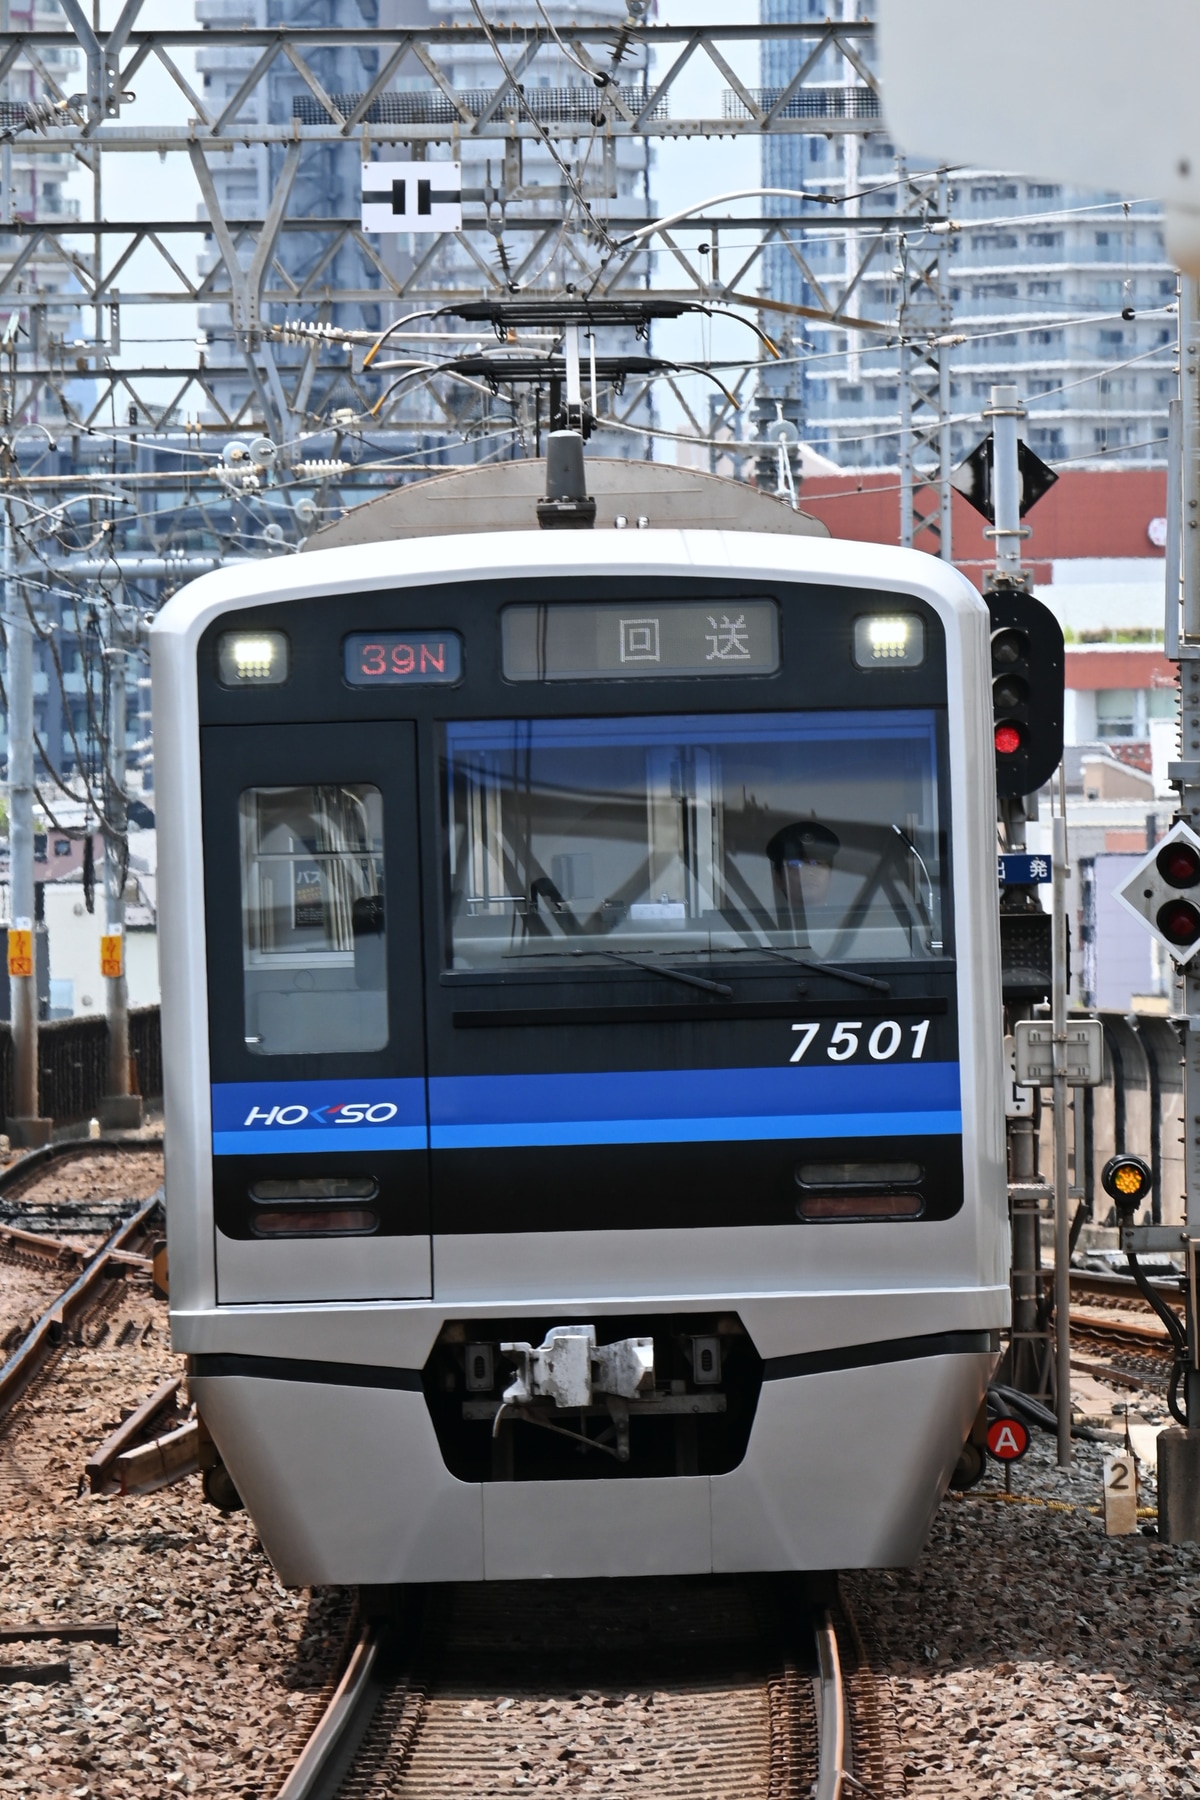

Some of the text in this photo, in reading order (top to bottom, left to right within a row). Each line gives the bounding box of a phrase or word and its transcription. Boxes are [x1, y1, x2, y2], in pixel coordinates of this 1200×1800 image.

[619, 615, 751, 663] 回送
[361, 643, 446, 676] 39N
[789, 1020, 931, 1062] 7501
[994, 1426, 1019, 1453] A
[1109, 1463, 1129, 1490] 2
